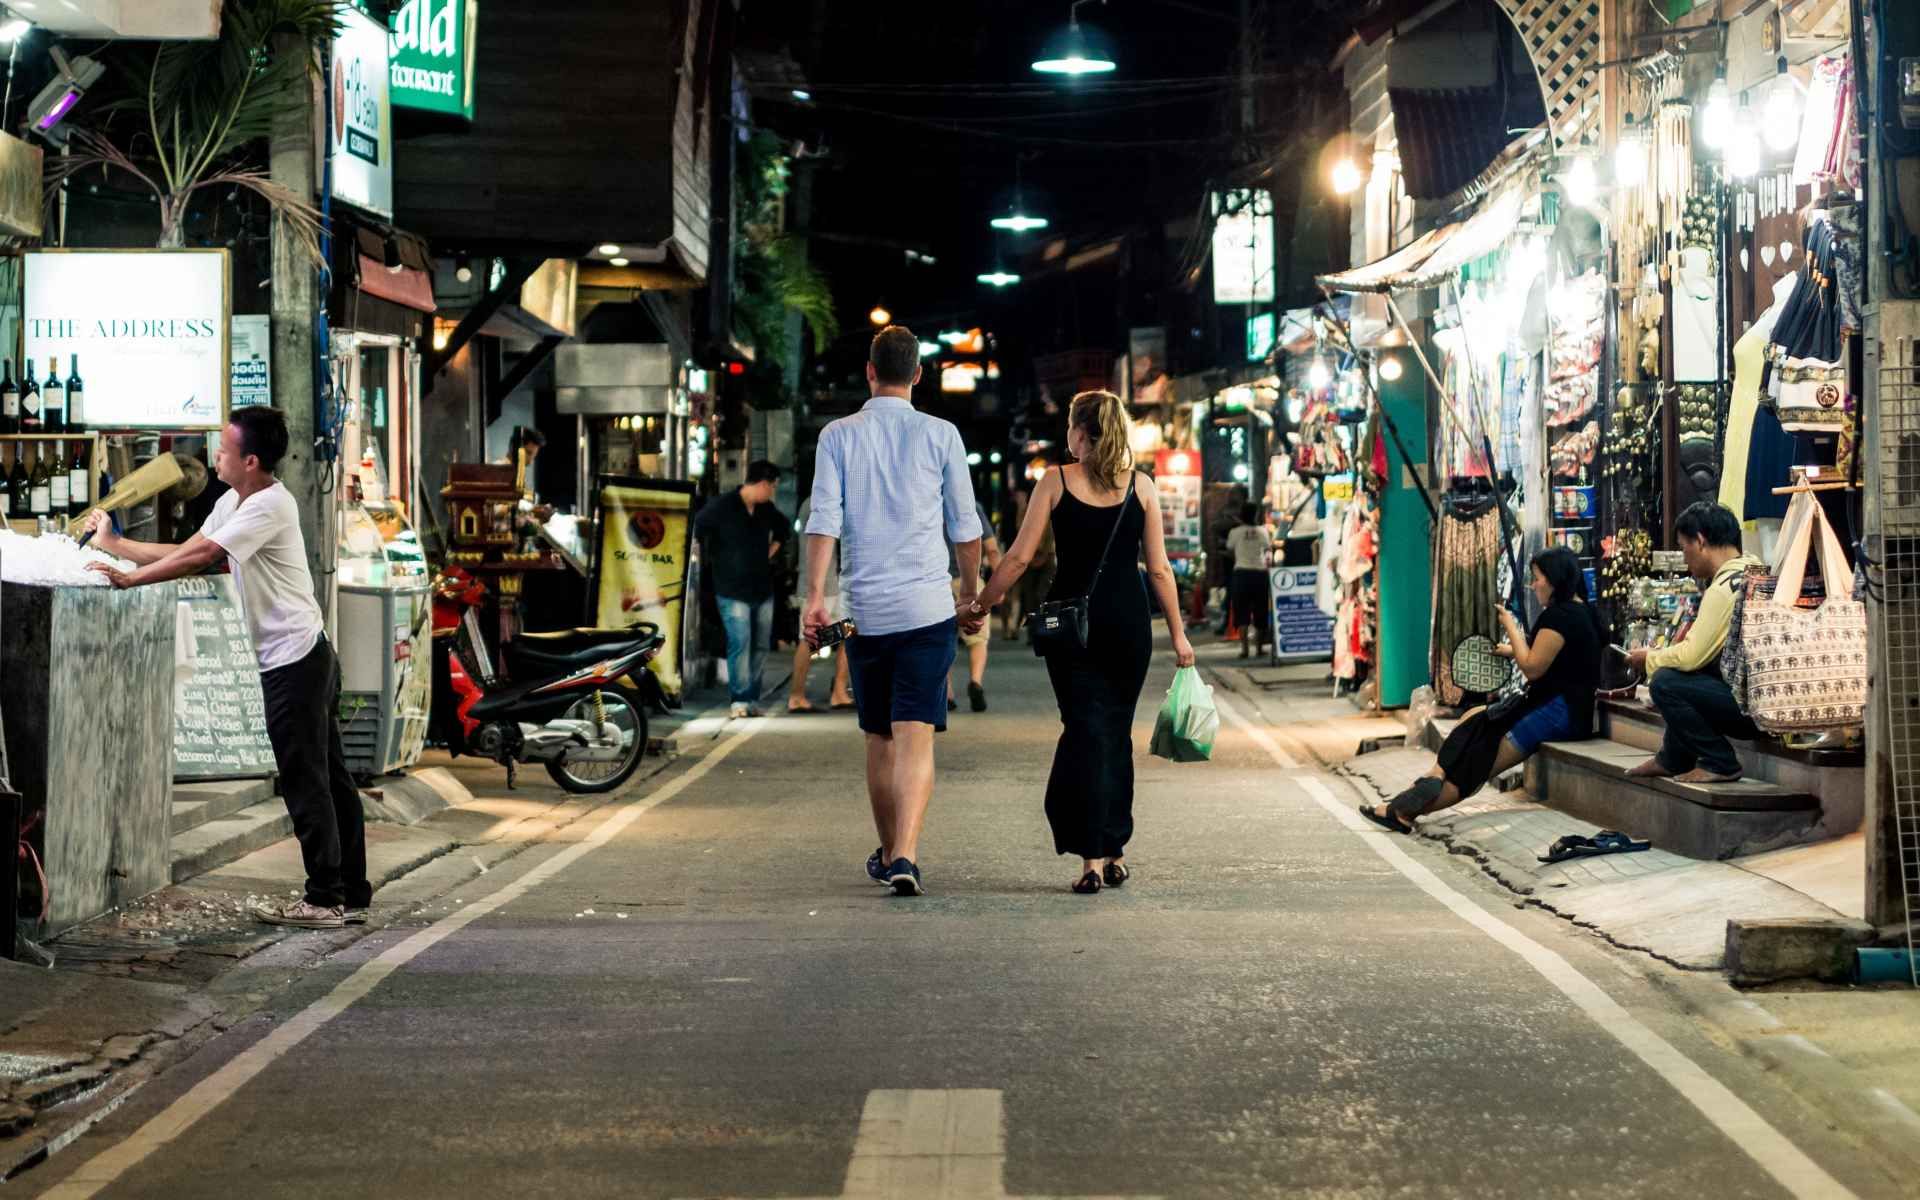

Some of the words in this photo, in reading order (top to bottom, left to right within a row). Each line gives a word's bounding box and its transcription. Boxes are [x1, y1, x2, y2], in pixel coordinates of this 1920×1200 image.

[29, 318, 81, 338] THE
[90, 318, 215, 338] ADDRESS
[652, 553, 675, 565] BAR
